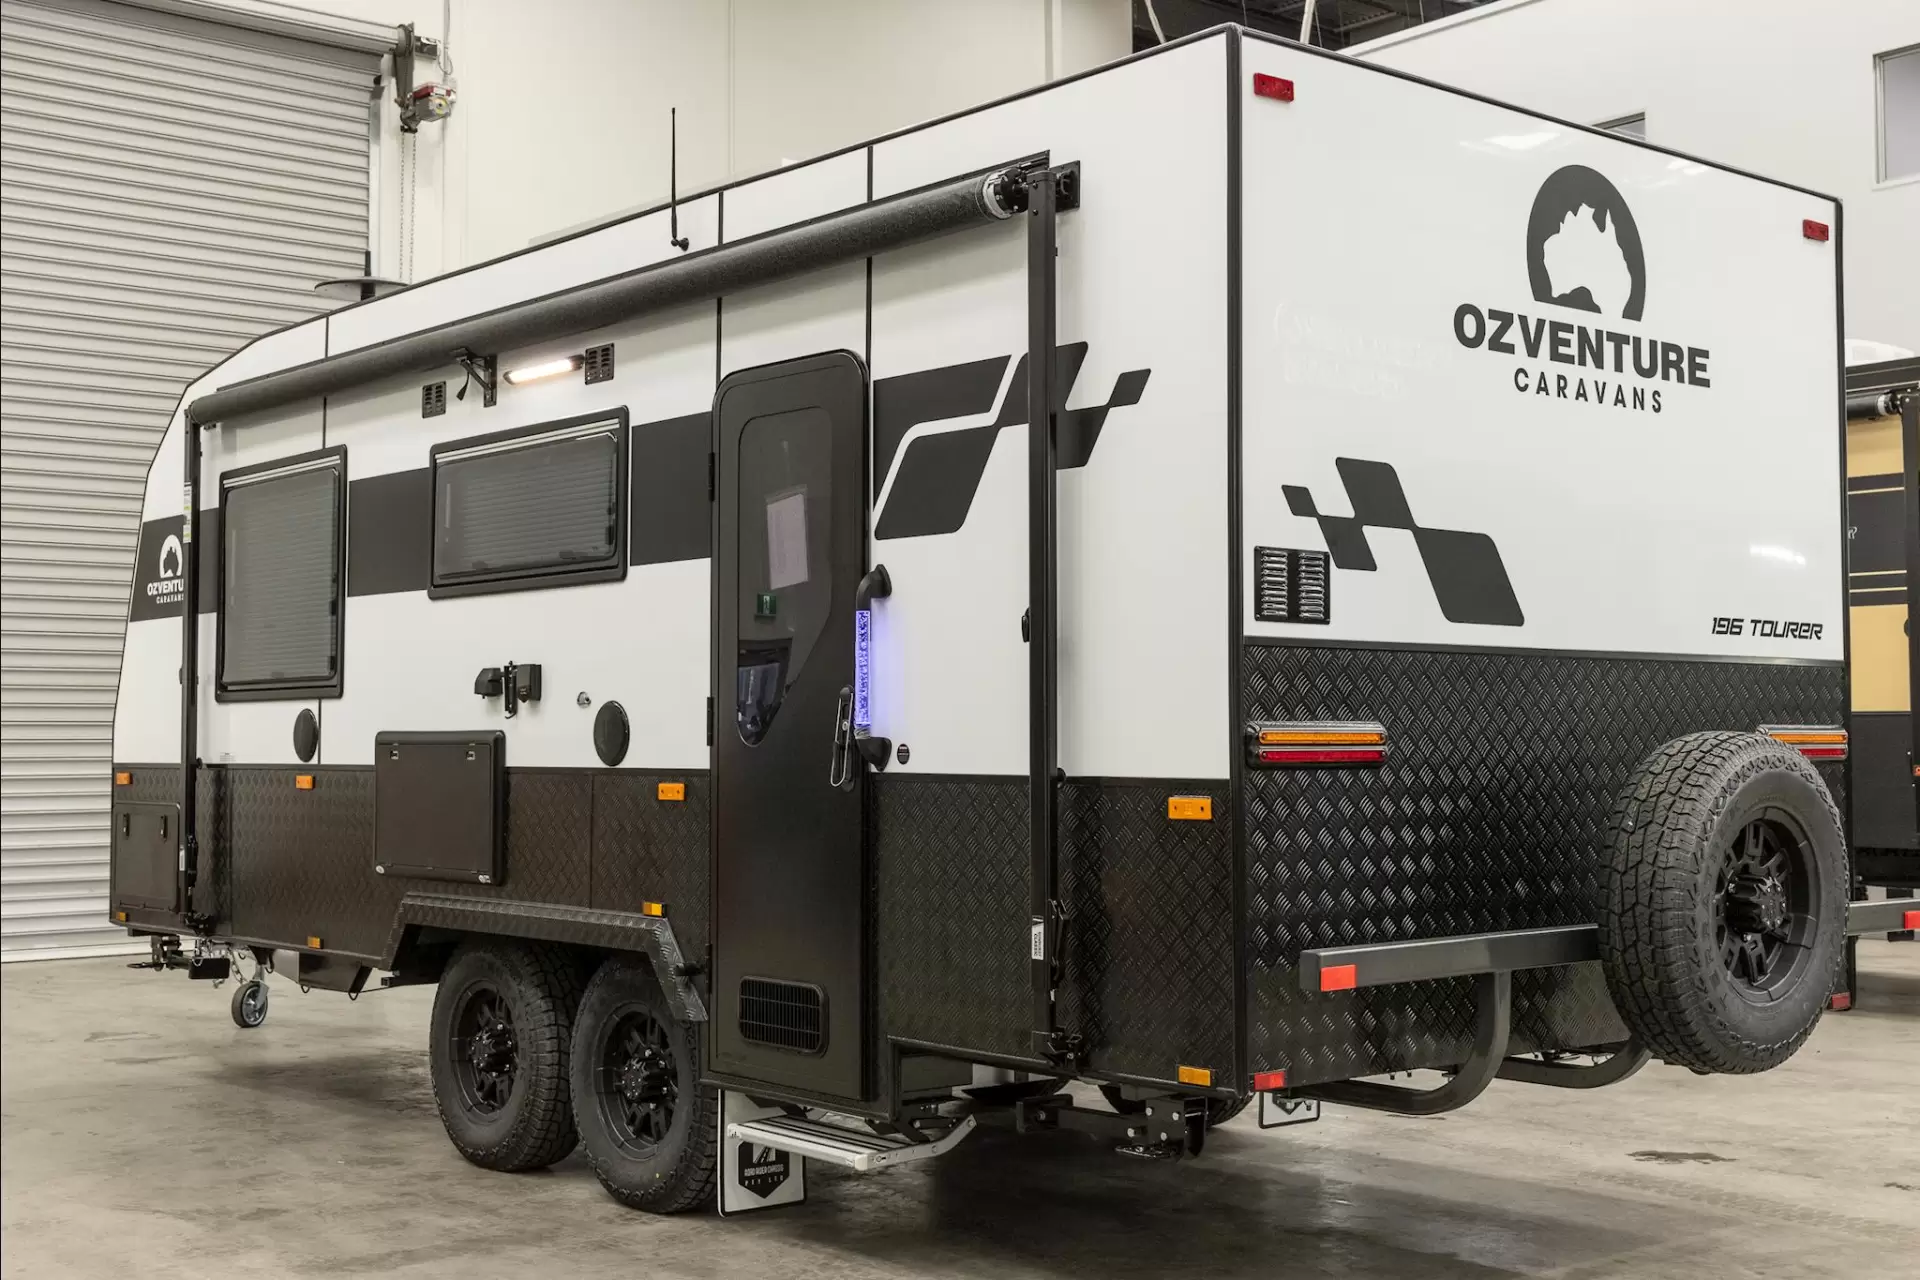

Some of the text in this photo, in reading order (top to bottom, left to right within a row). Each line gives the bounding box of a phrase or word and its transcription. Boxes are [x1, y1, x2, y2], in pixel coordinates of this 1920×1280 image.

[1453, 303, 1711, 388] OZVENTURE
[1514, 367, 1662, 413] CARAVANS
[147, 578, 184, 596] OZVENTU
[1711, 617, 1823, 640] 196 TOURER
